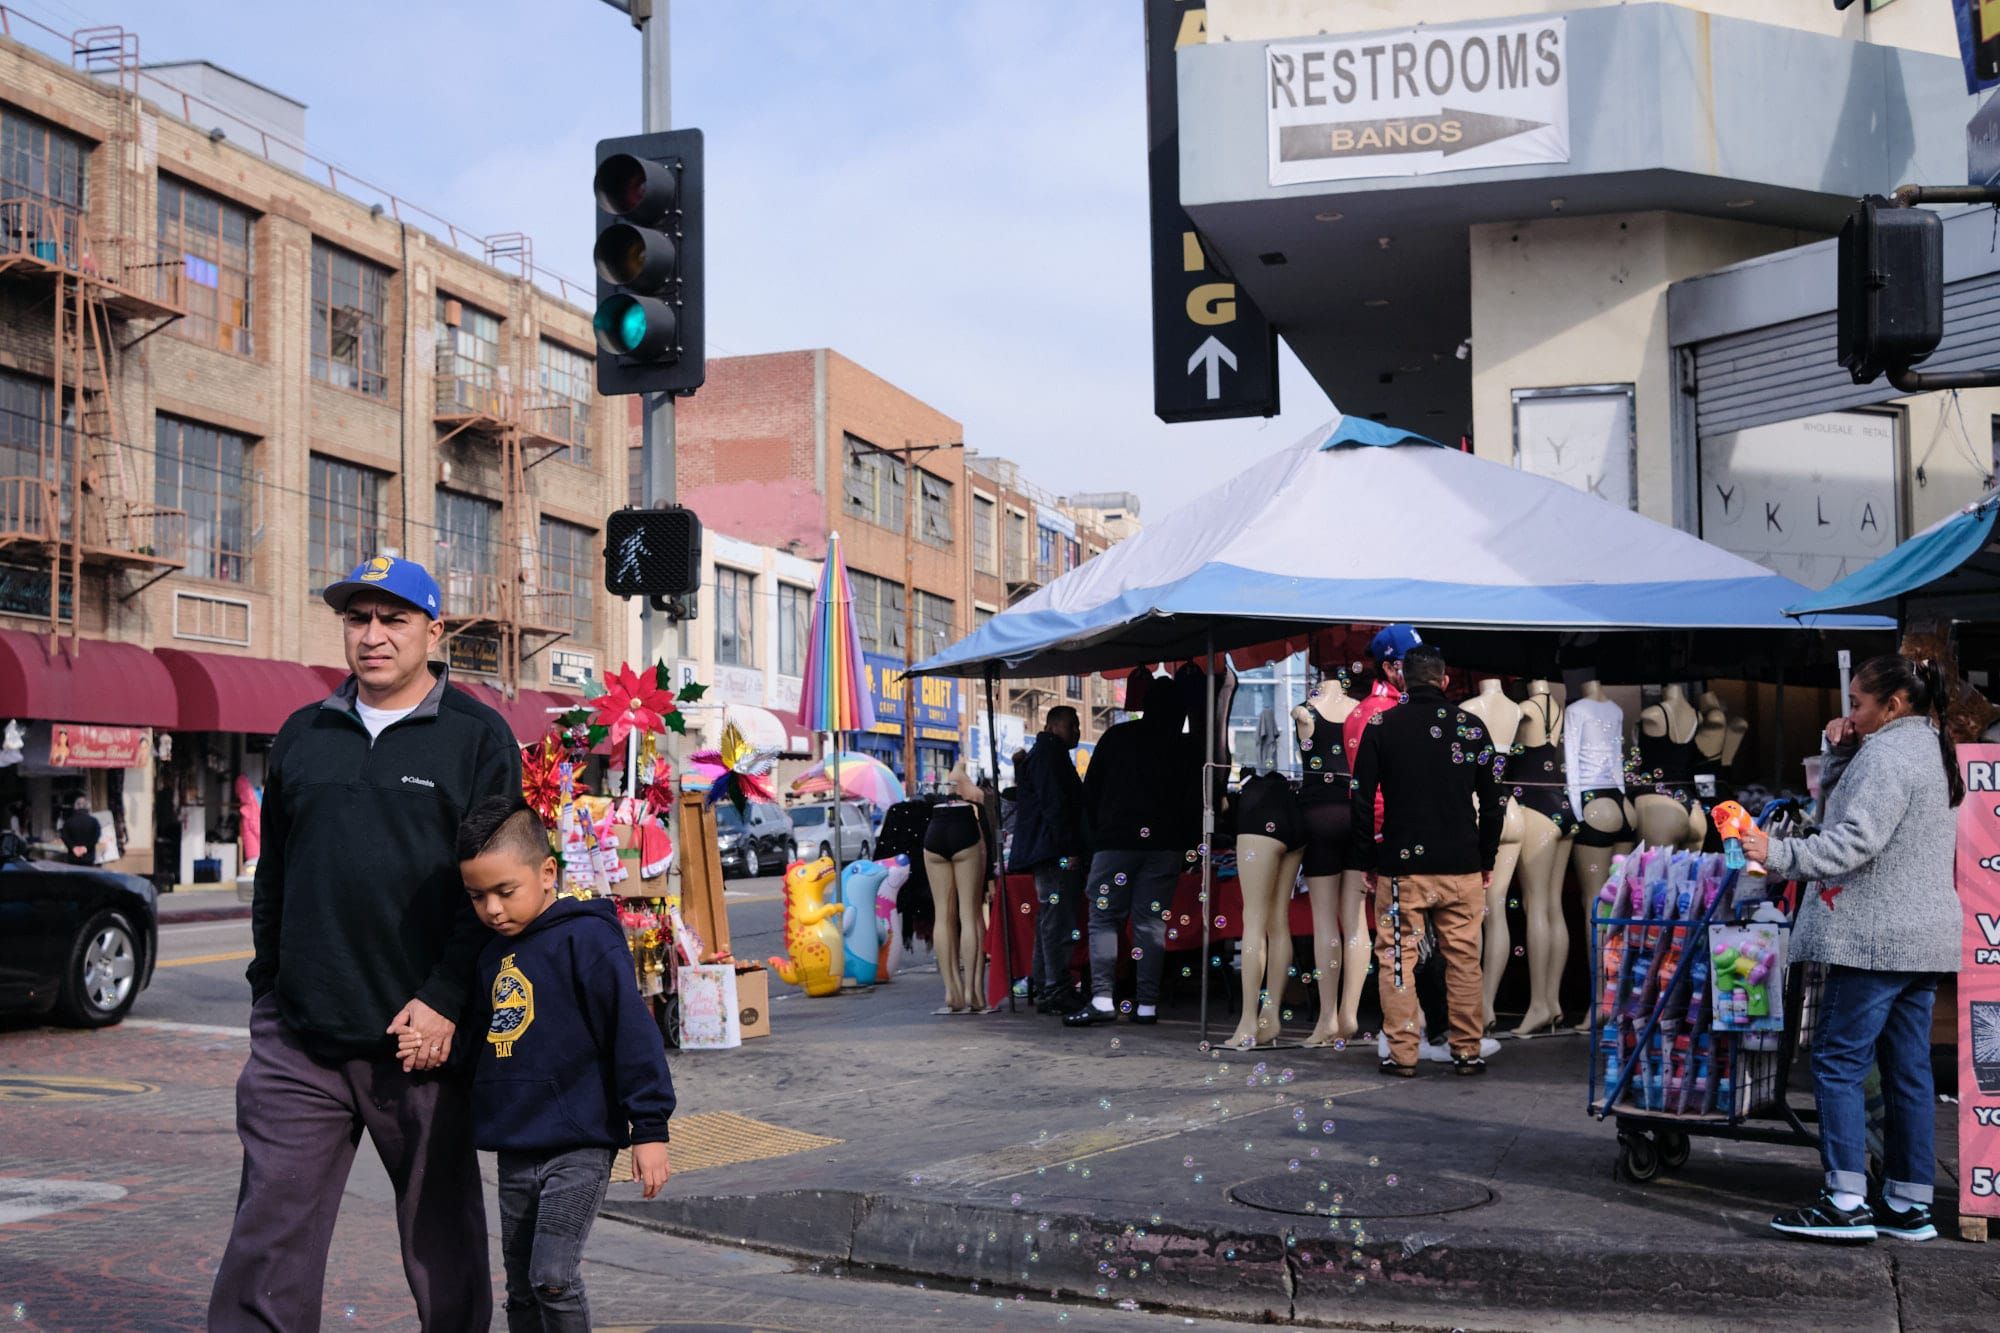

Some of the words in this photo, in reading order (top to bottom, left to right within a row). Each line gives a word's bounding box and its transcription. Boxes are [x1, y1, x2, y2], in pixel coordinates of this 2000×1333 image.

[1271, 29, 1561, 109] RESTROOMS
[1331, 120, 1463, 151] BAÑOS
[1803, 422, 1853, 436] WHOLESALE
[1862, 427, 1890, 438] RETAIL
[921, 675, 952, 709] CRAFT
[409, 776, 435, 788] Columbia
[501, 953, 516, 971] THE
[495, 1041, 513, 1057] BAY
